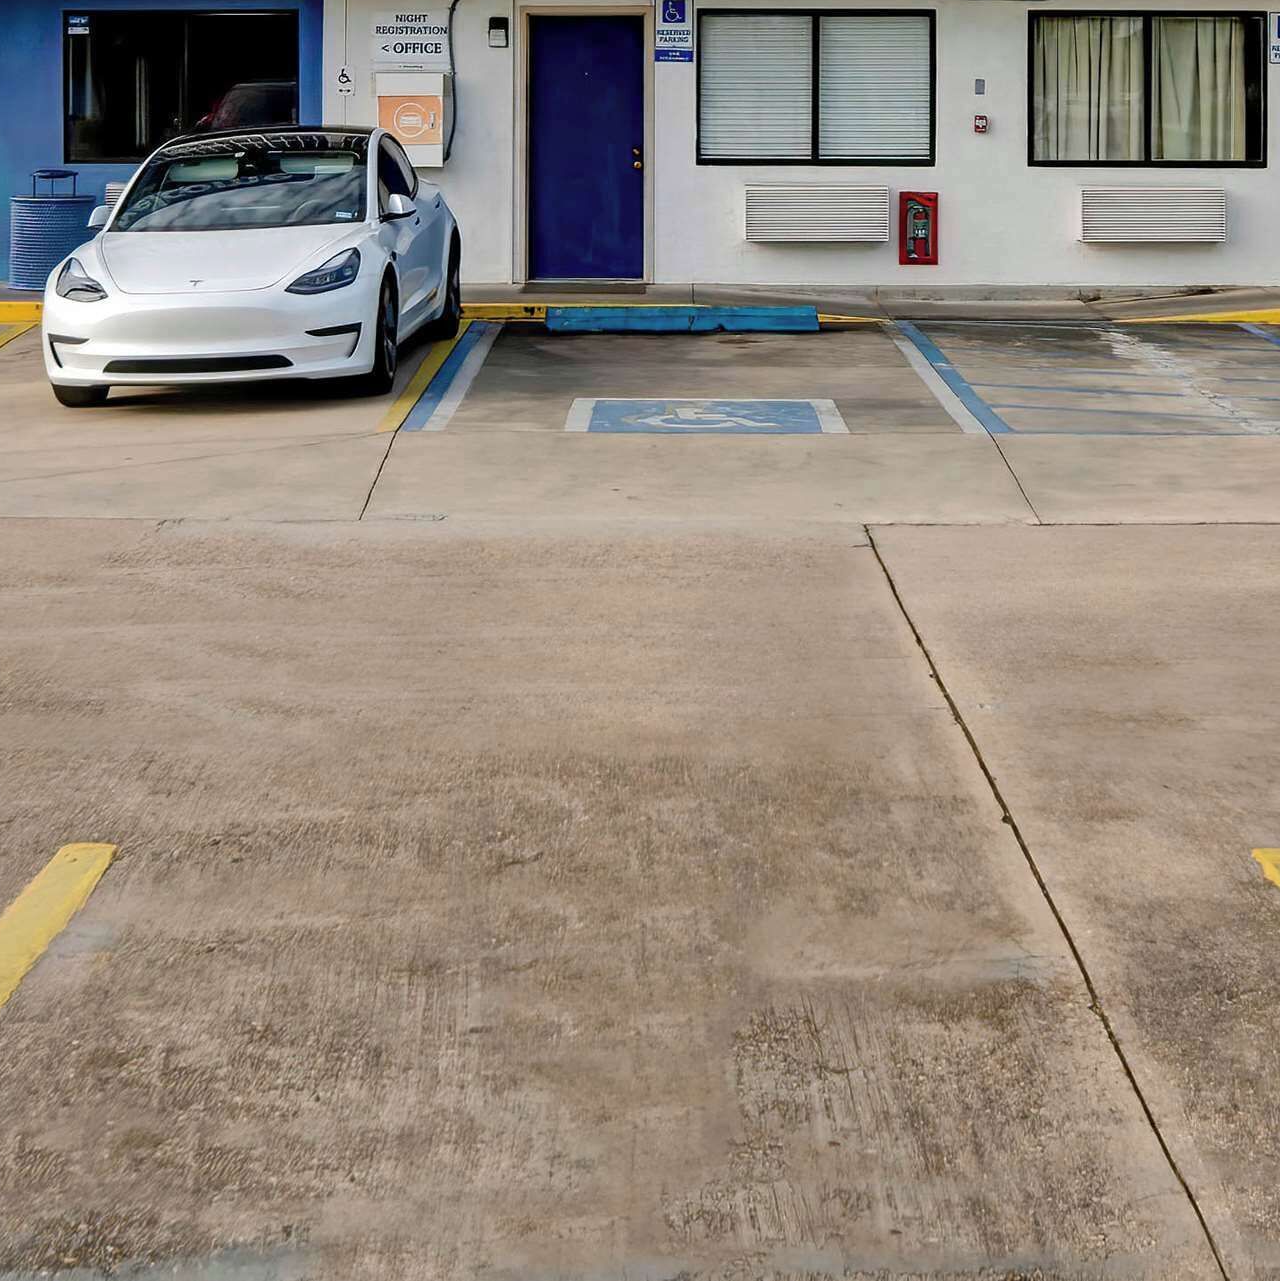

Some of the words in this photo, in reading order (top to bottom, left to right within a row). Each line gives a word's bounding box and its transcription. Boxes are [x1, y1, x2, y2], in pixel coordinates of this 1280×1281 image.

[395, 14, 428, 23] NIGHT
[375, 26, 448, 35] REGISTRATION
[393, 42, 442, 54] OFFICE
